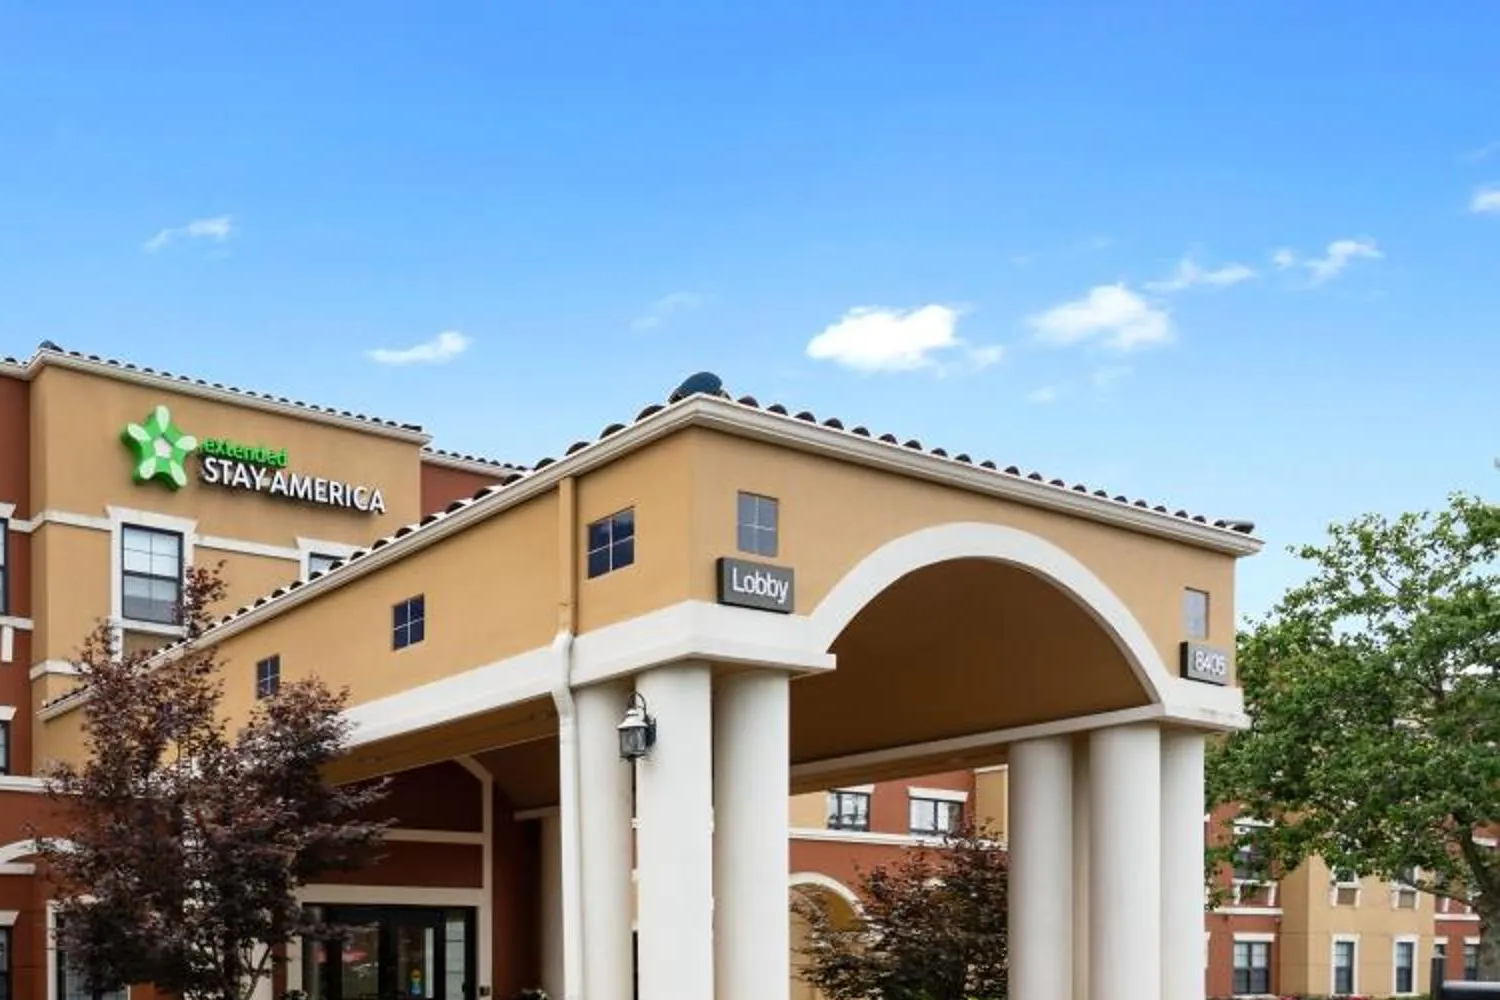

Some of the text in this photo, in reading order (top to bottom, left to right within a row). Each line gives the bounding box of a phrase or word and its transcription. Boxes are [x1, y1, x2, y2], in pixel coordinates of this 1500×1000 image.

[203, 438, 288, 466] extended
[204, 456, 385, 513] STAY AMERICA
[732, 567, 789, 603] Lobby
